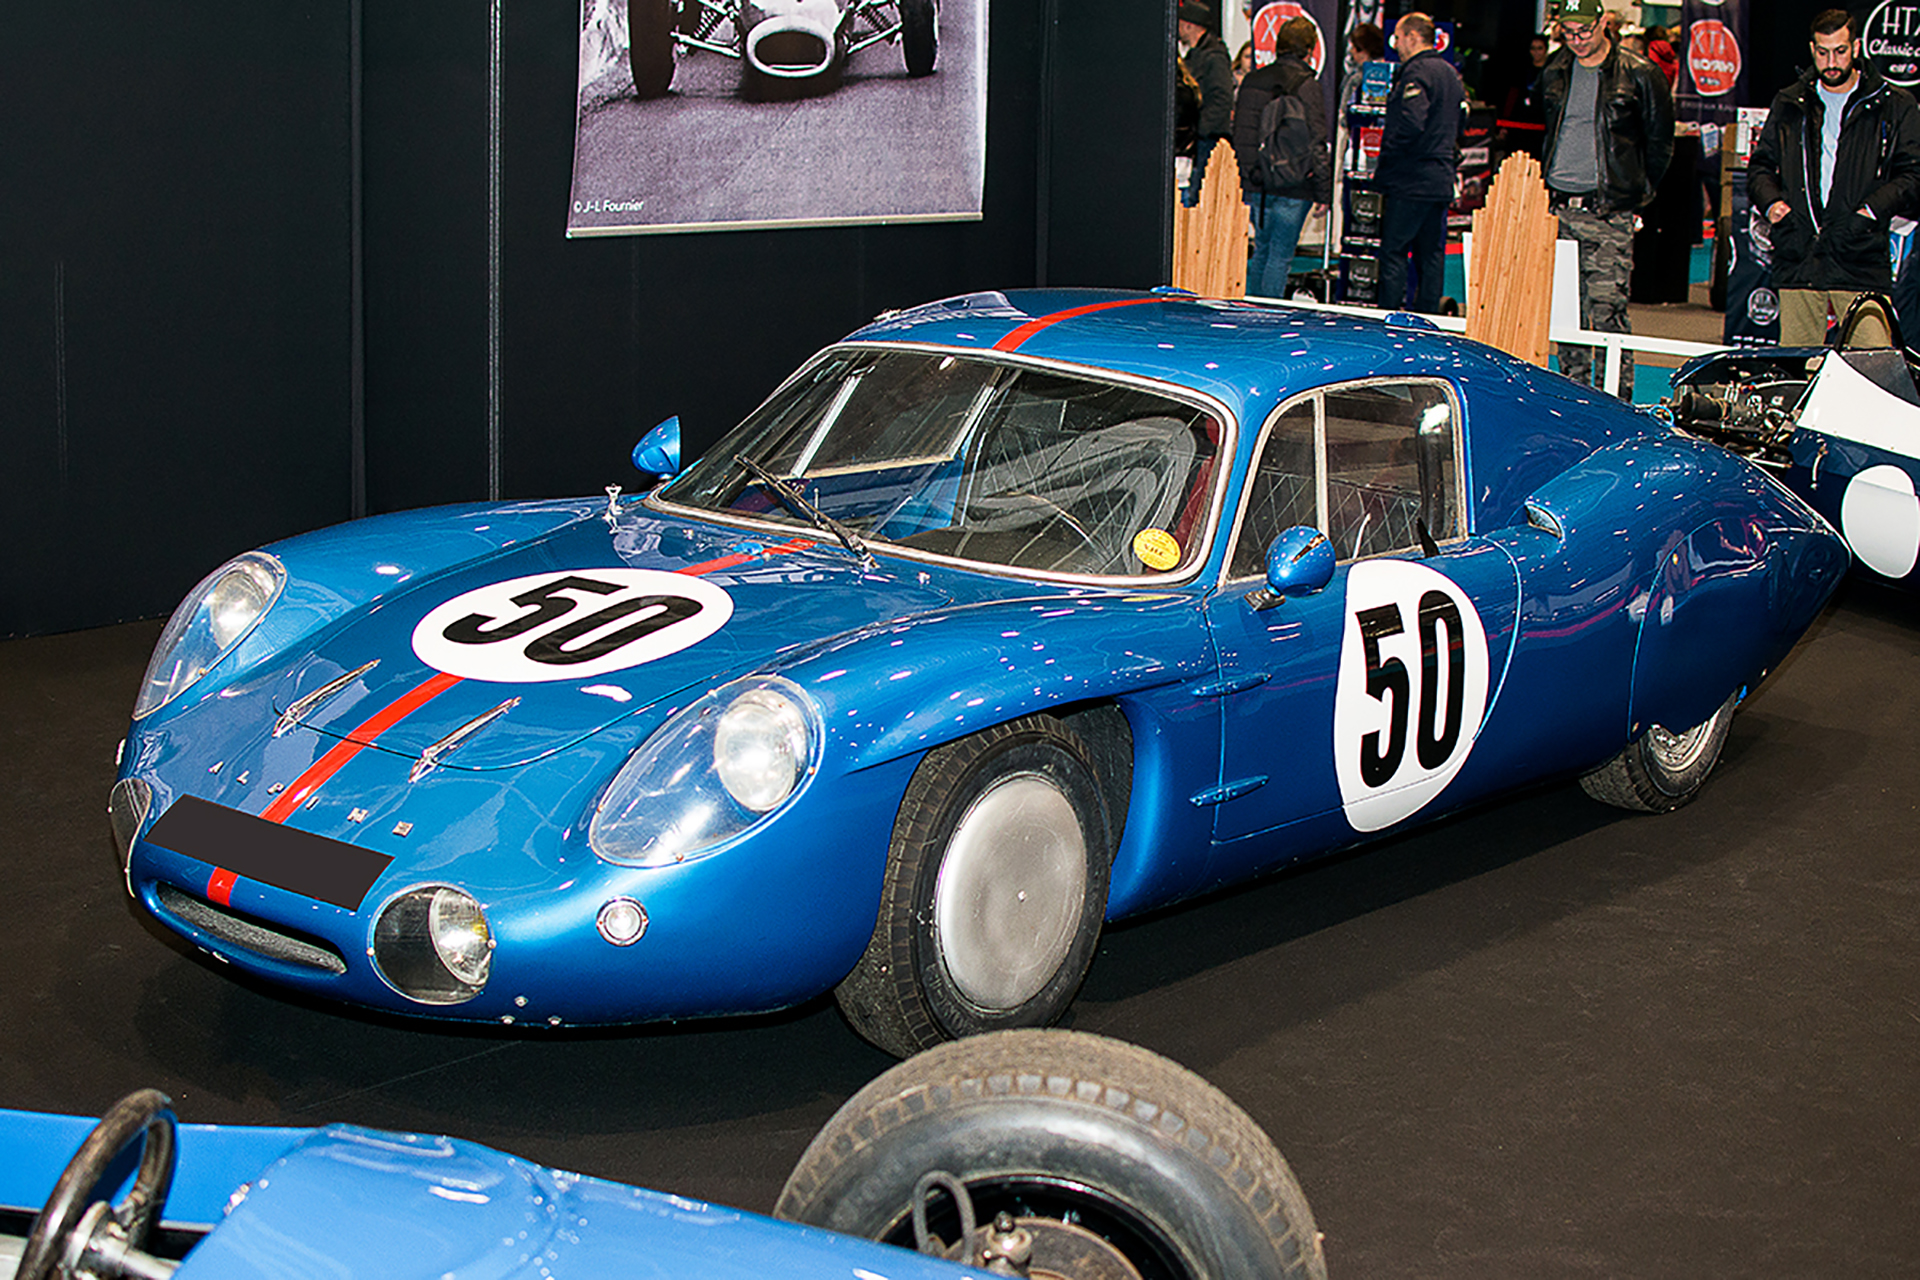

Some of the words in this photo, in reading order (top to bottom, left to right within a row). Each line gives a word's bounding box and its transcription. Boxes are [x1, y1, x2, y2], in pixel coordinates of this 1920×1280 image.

[1869, 38, 1914, 57] Classic
[603, 199, 644, 212] Fournier
[441, 575, 704, 666] 50
[1355, 589, 1465, 788] 50
